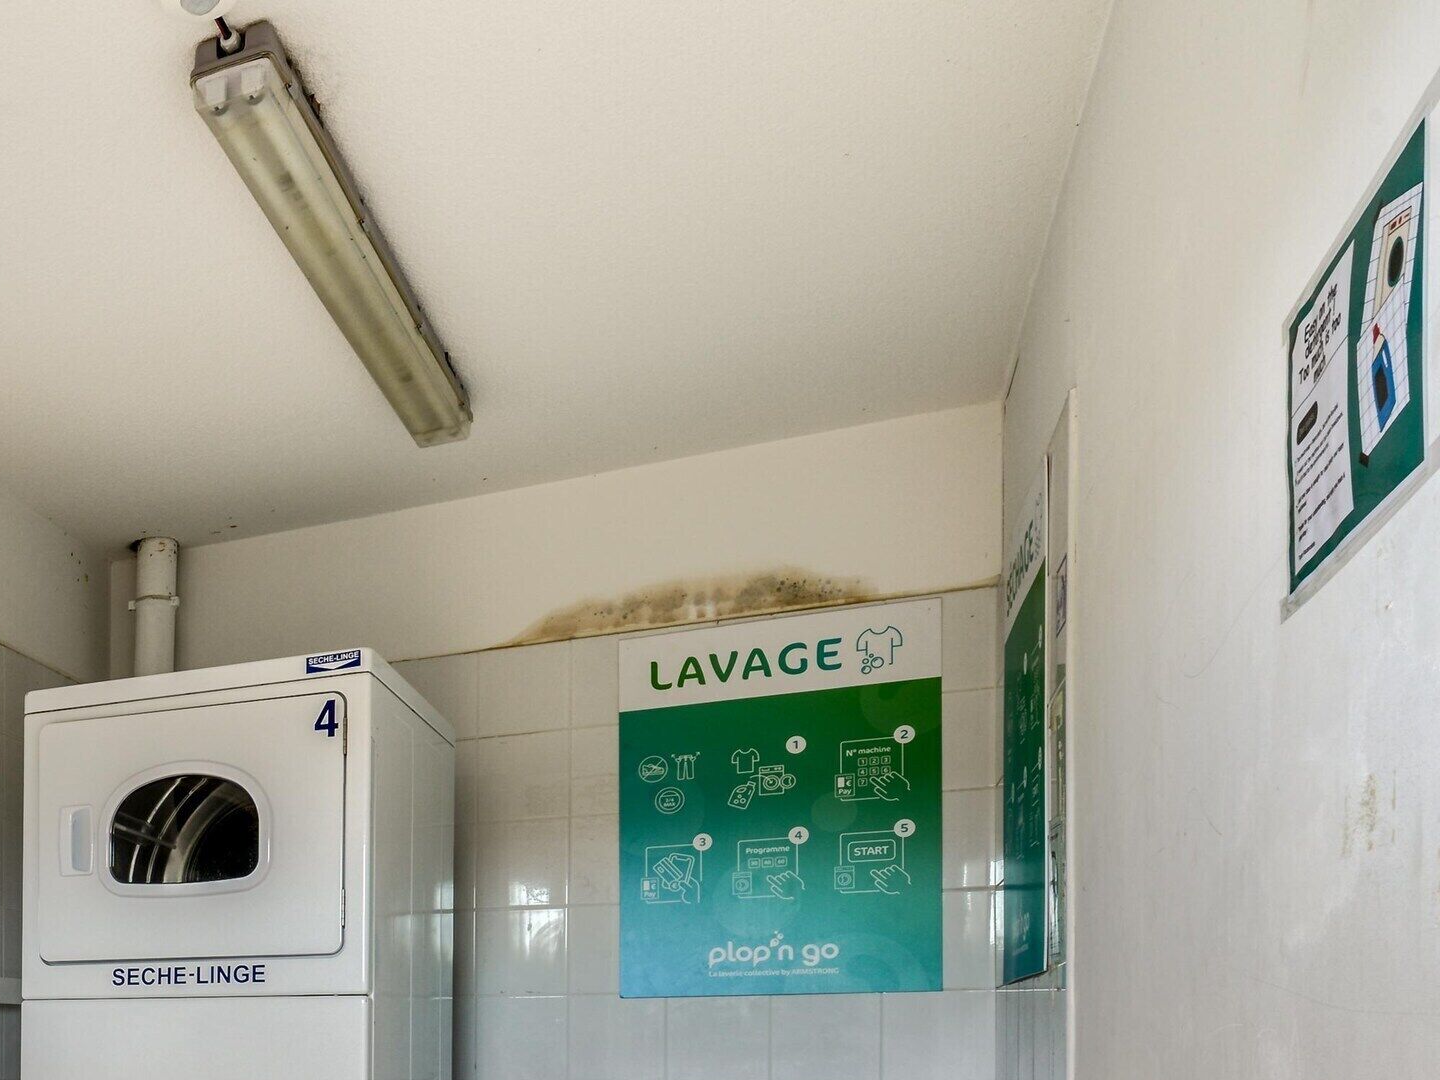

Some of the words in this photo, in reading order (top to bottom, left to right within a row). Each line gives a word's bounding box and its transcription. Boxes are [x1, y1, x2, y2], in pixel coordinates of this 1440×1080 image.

[309, 651, 359, 664] SECHE-LINGE
[651, 637, 843, 691] LAVAGE
[314, 700, 339, 737] 4
[900, 730, 908, 739] 2
[793, 741, 798, 749] 1
[858, 746, 891, 754] machine
[901, 823, 908, 832] 5
[795, 831, 802, 839] 4
[699, 838, 706, 846] 3
[745, 845, 790, 855] Programme
[853, 844, 890, 856] START
[801, 943, 840, 966] go
[112, 965, 266, 986] SECHE-LINGE
